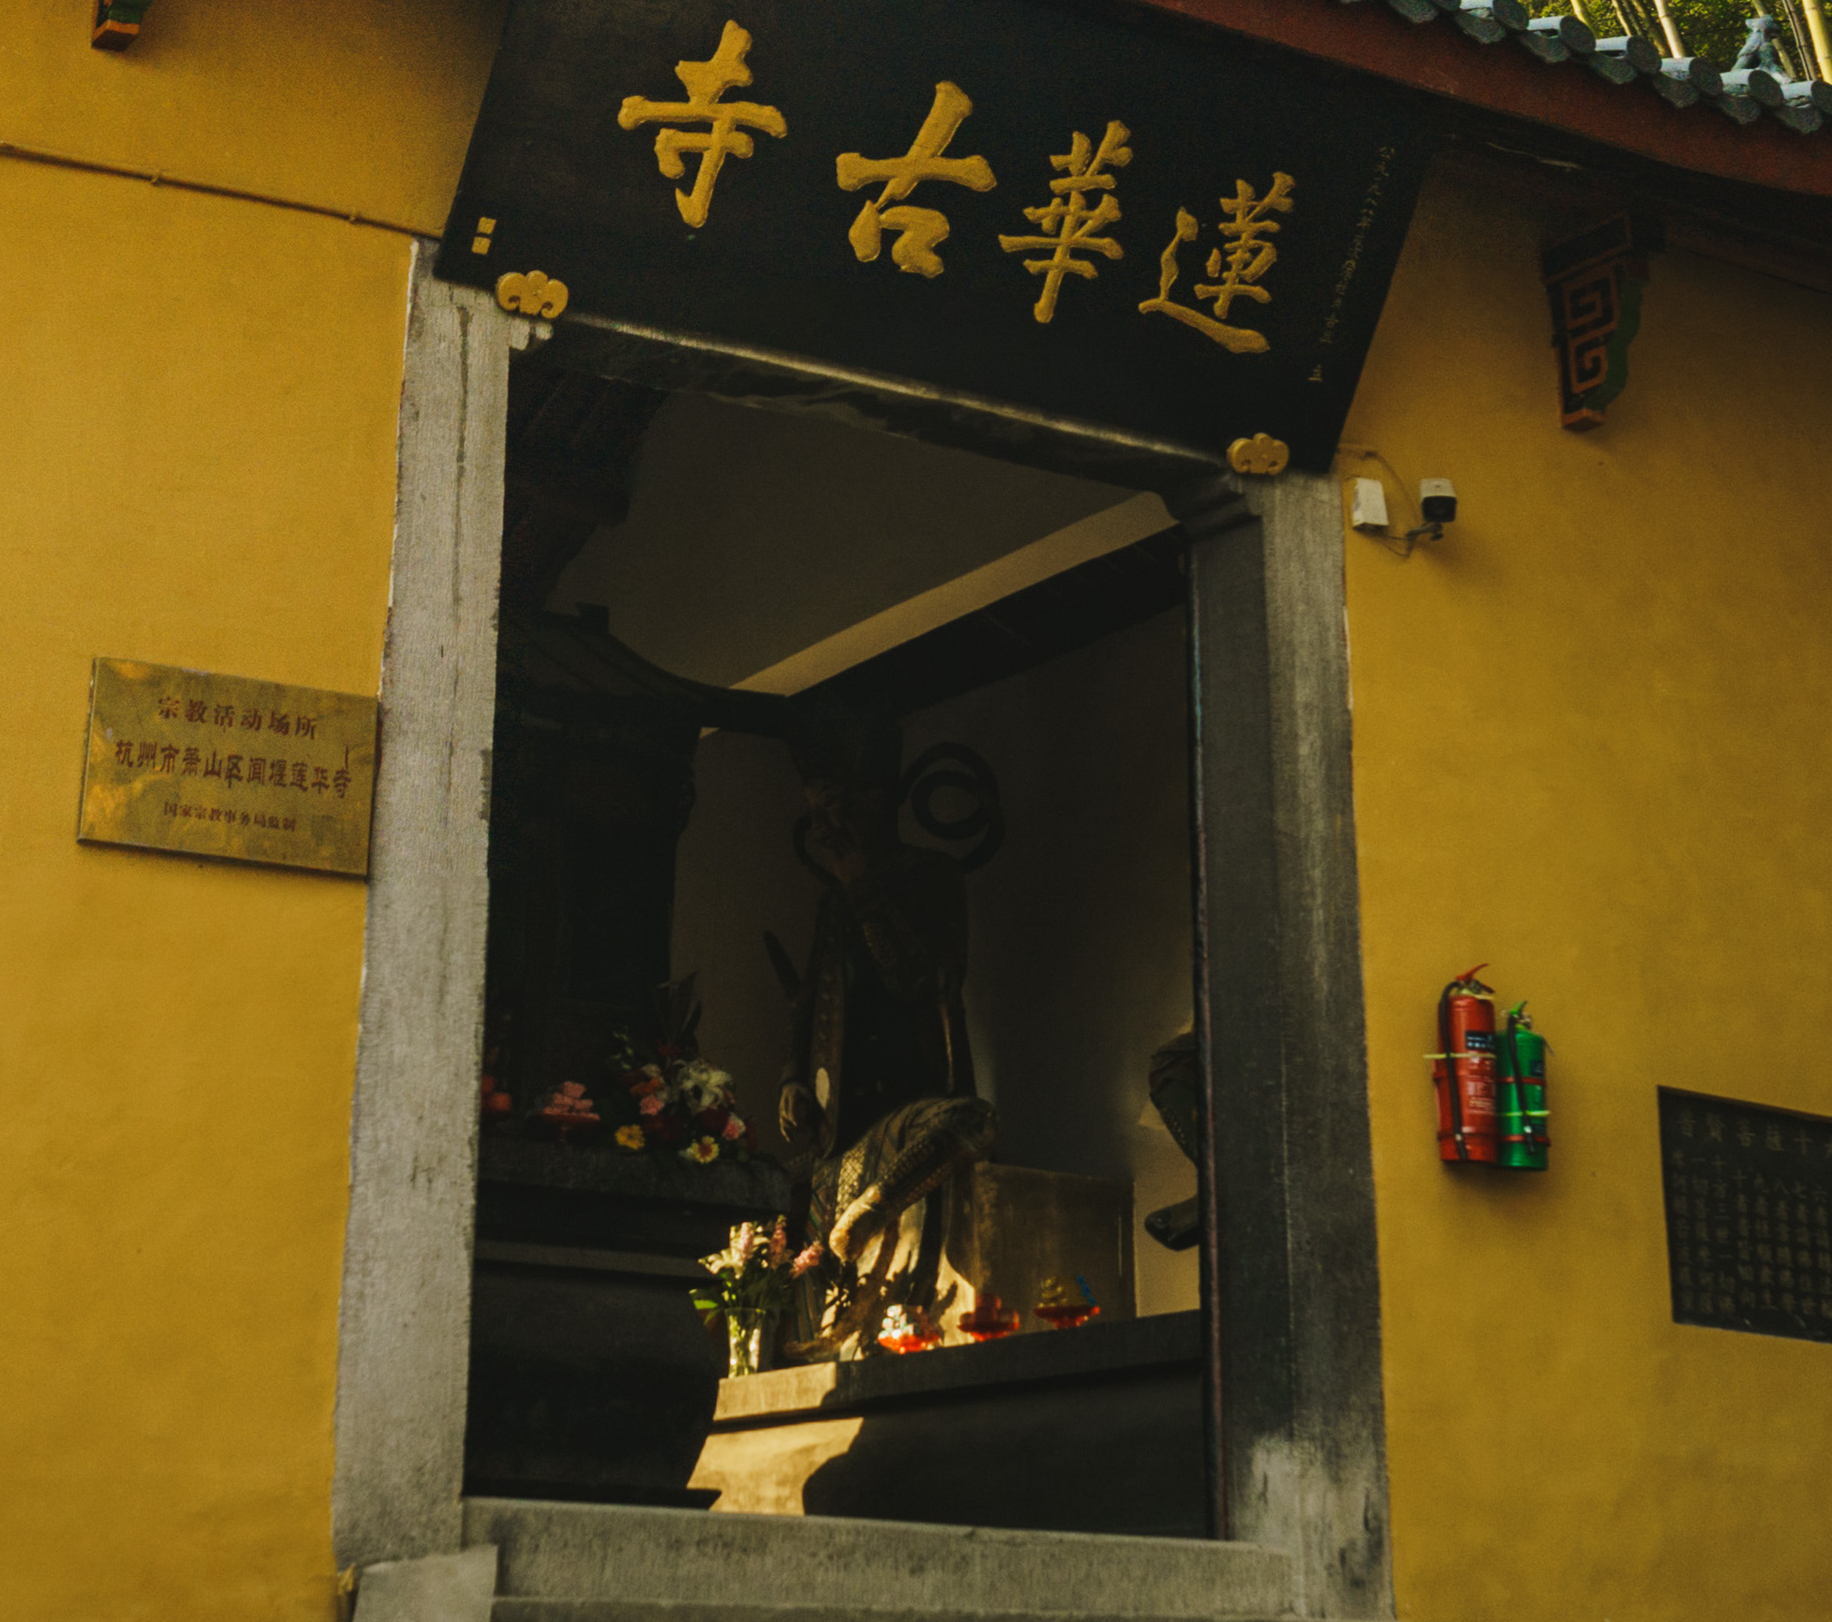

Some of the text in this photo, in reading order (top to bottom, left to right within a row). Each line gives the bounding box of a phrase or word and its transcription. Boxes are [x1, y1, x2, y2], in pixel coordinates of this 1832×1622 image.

[157, 695, 318, 741] 宗教活动场所
[114, 739, 353, 800] 杭州市萧山区闻堰莲华寺
[163, 800, 298, 833] 国家宗教事务局监制
